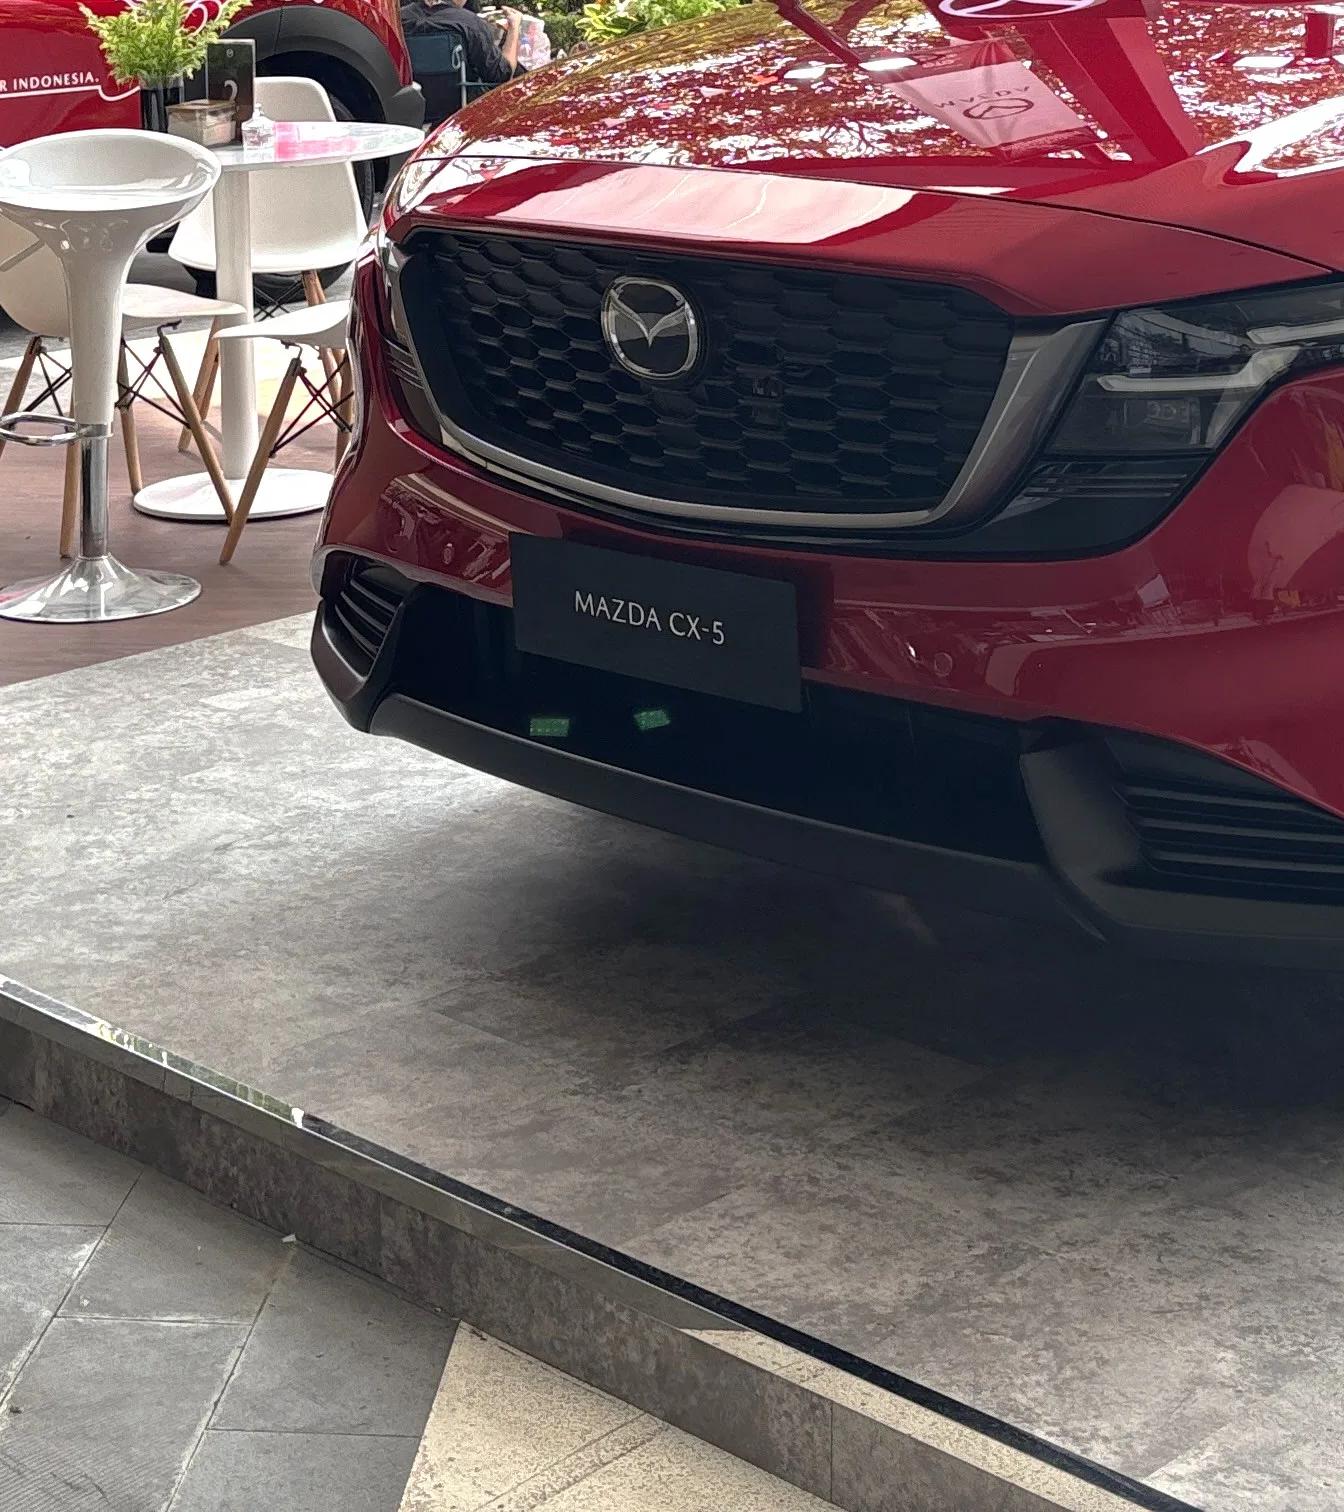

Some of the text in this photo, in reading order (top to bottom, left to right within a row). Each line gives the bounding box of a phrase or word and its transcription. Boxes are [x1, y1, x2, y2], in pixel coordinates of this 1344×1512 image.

[13, 71, 100, 90] INDONESIA.
[574, 590, 726, 645] MAZDA CX-5
